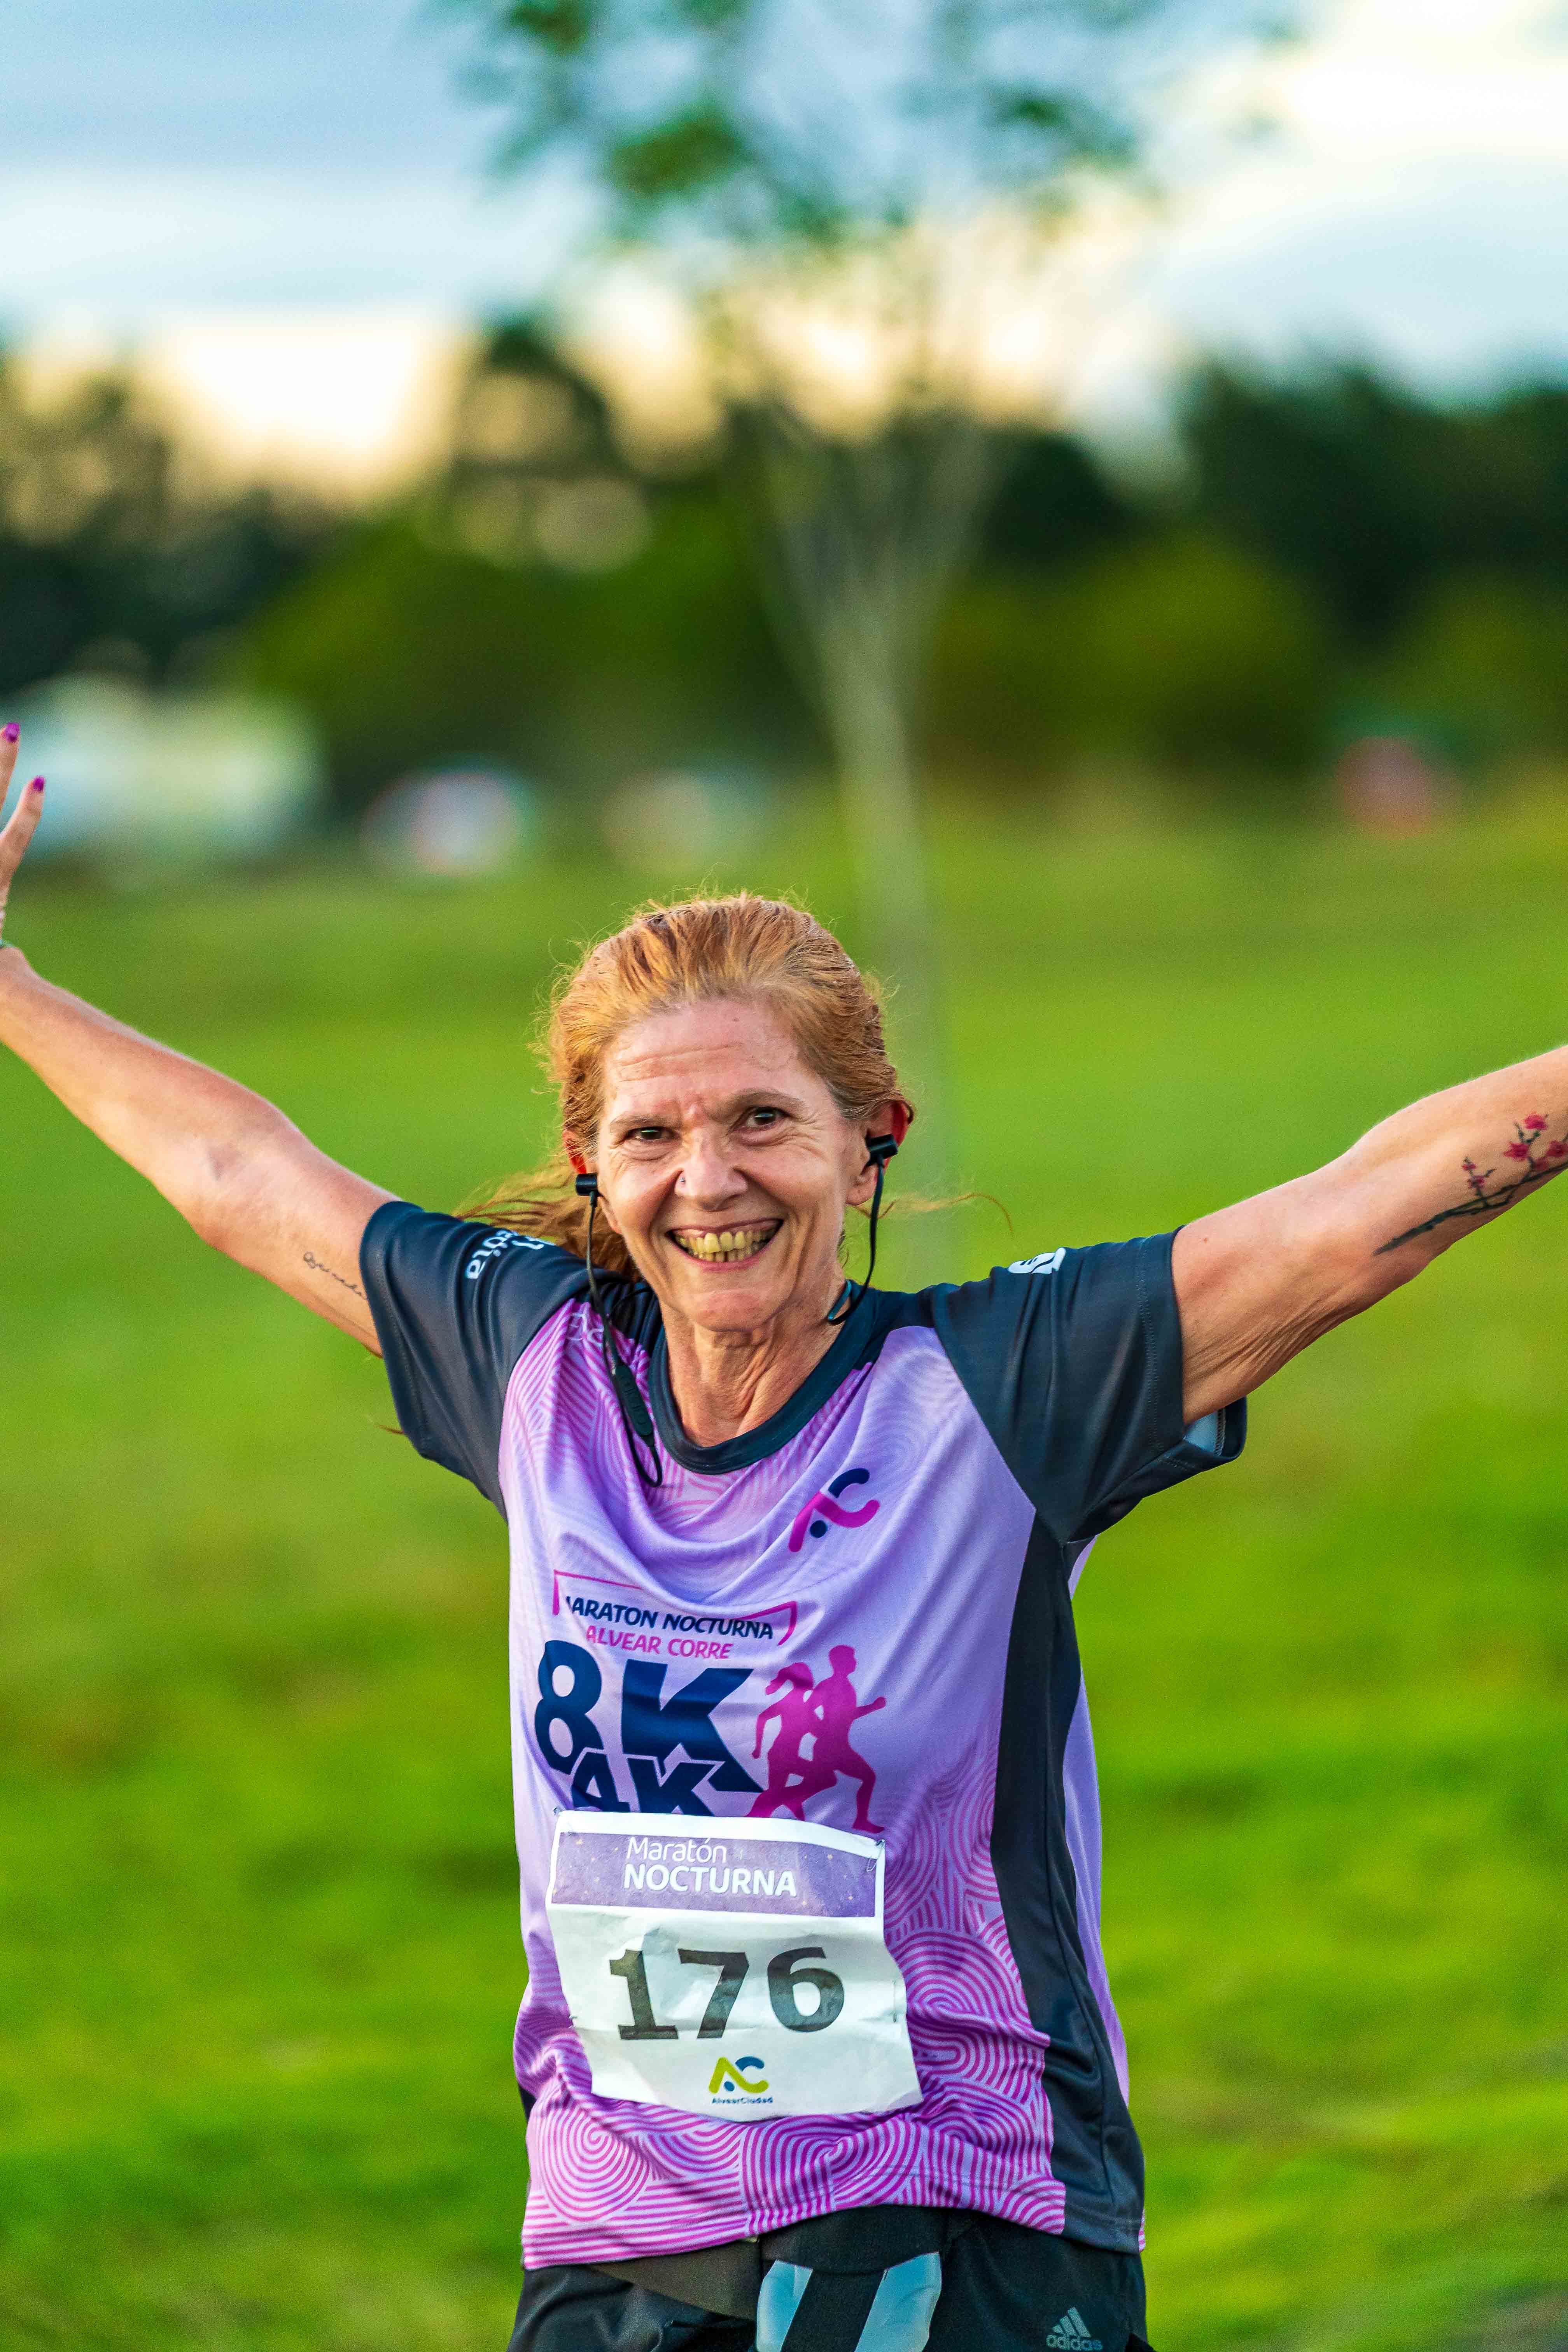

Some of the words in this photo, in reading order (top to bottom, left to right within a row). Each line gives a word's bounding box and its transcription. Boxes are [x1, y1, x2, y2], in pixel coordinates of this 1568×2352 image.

[586, 1625, 662, 1654] ALVEAR
[667, 1638, 734, 1659] CORRE
[662, 1613, 773, 1639] NOCTURNA
[535, 1640, 765, 1793] 8K
[626, 1837, 727, 1864] Maratón
[623, 1863, 797, 1897] NOCTURNA
[609, 1946, 845, 2040] 176
[1046, 2334, 1103, 2351] adidas
